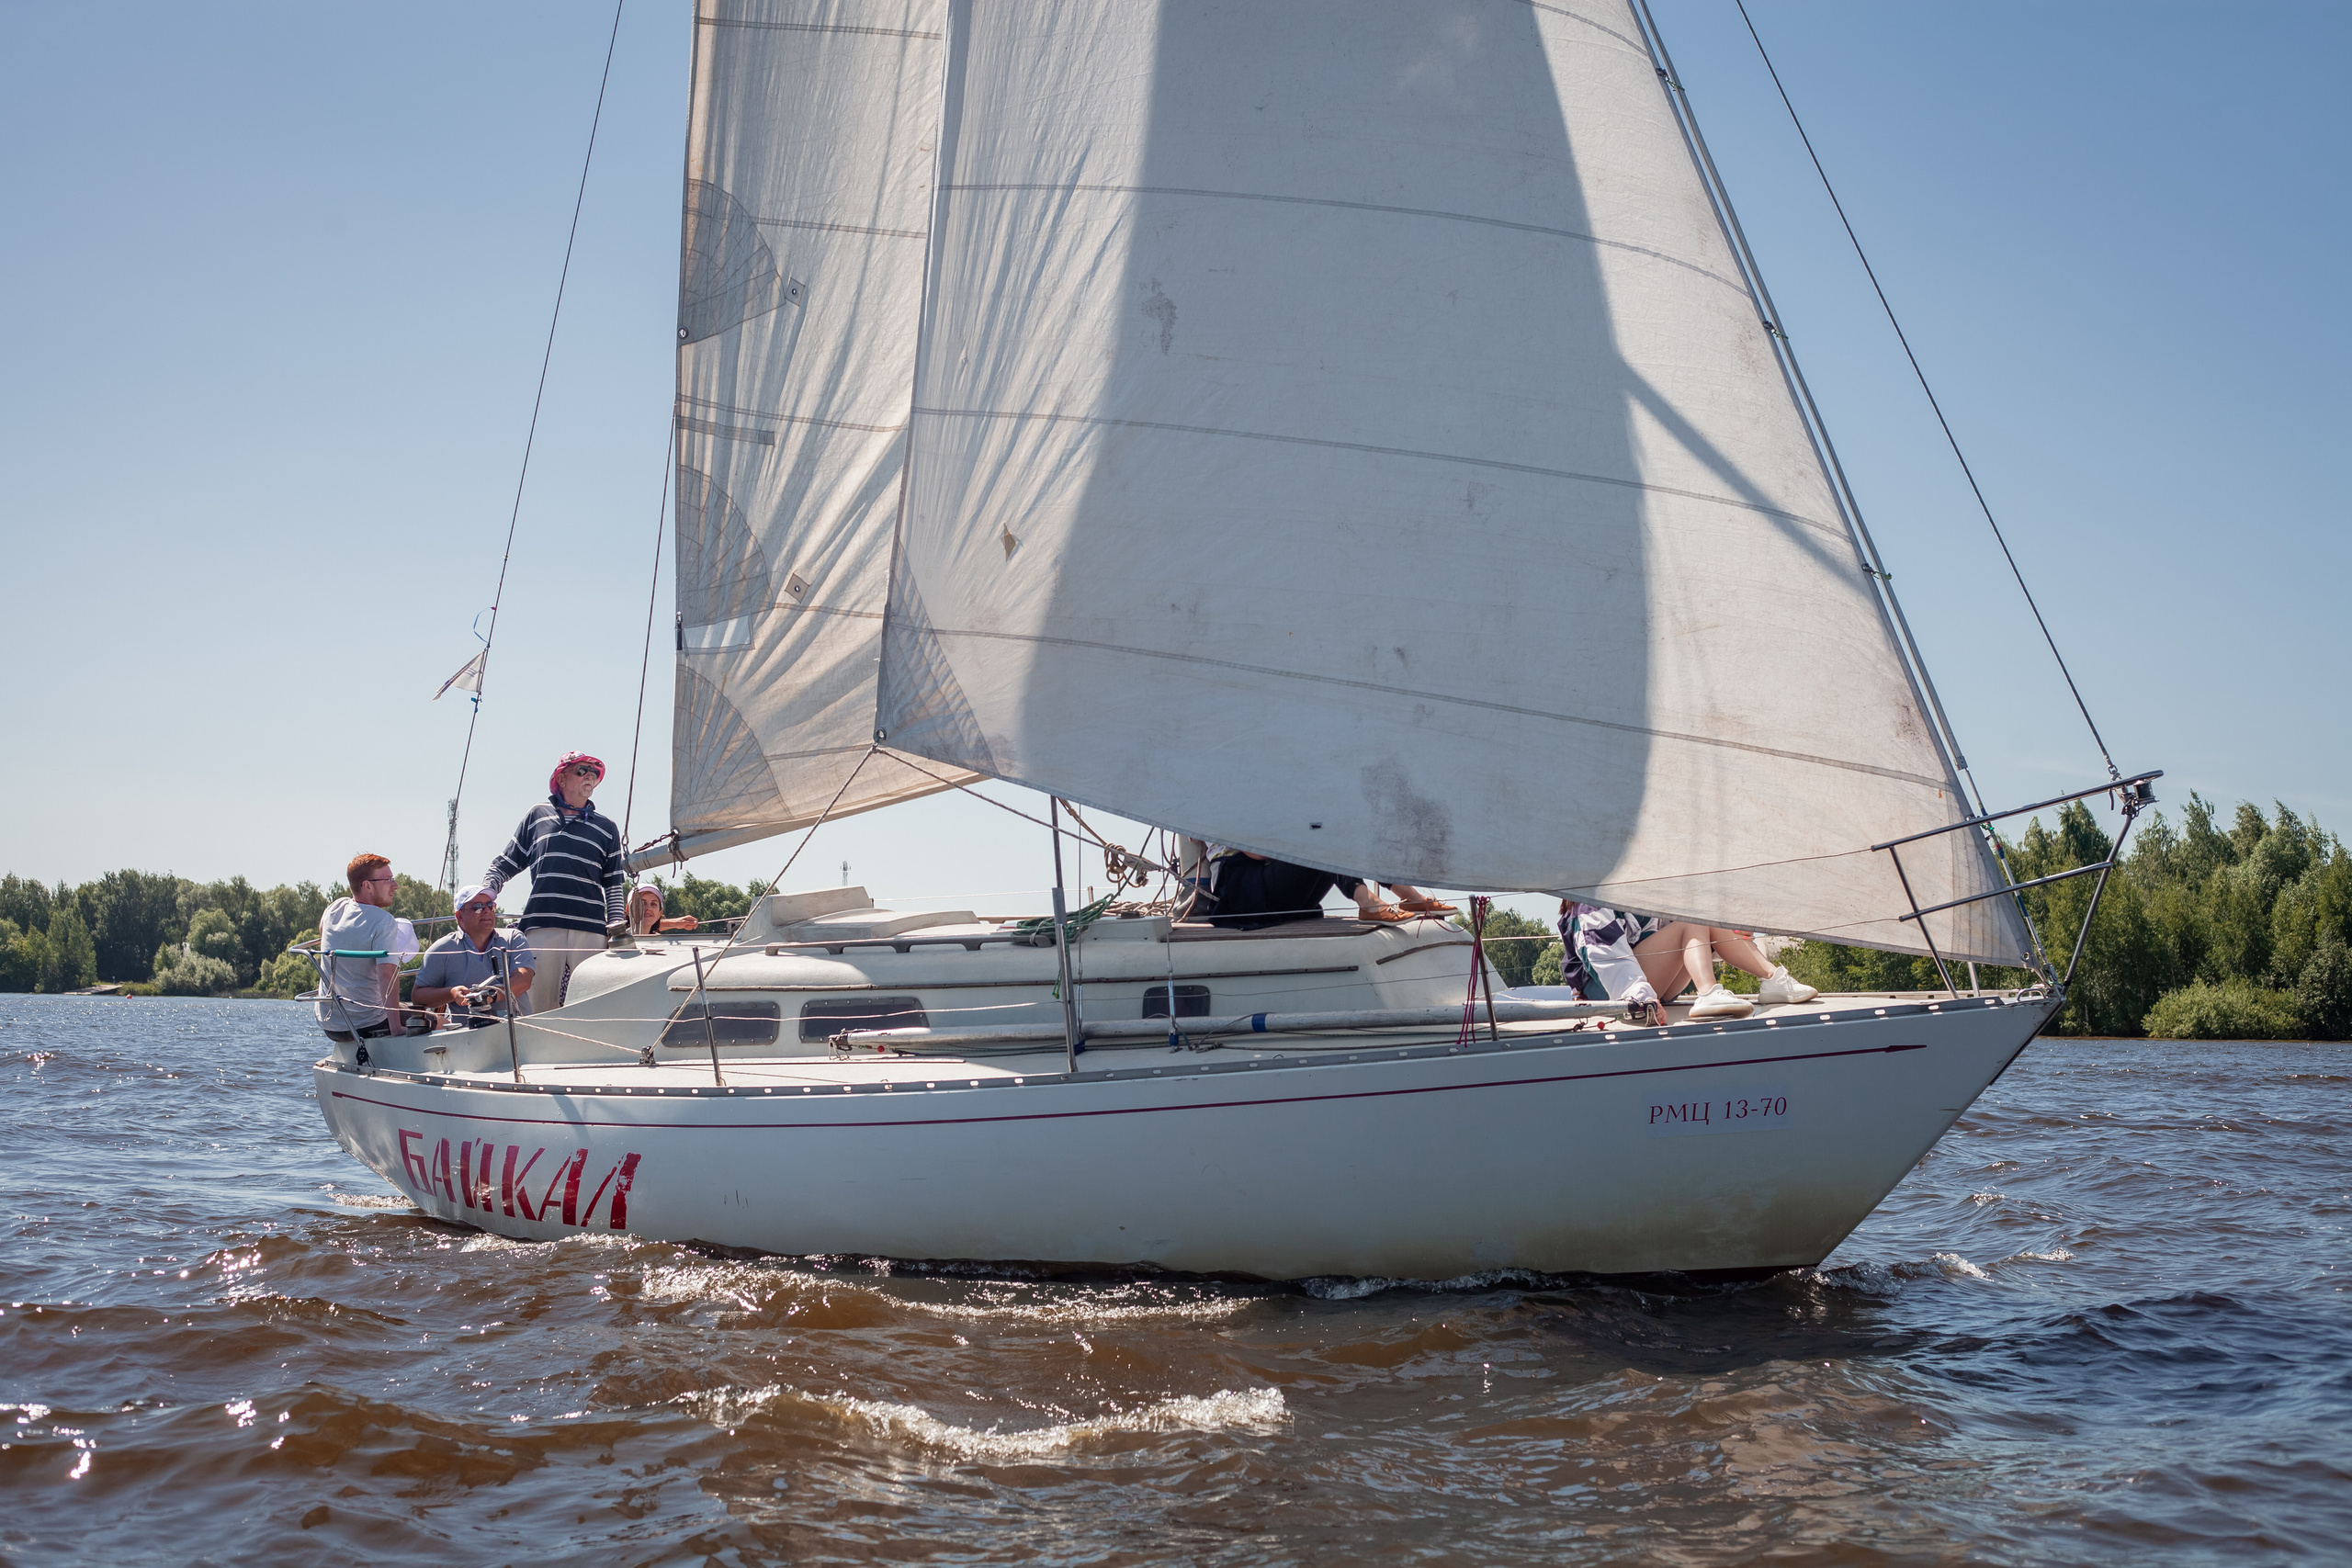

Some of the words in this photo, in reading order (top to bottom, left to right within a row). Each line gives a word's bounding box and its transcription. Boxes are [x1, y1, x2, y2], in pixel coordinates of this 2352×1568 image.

[1648, 1102, 1711, 1125] РМЦ
[1724, 1097, 1787, 1120] 13-70
[398, 1128, 641, 1230] БАЙКАЛ
